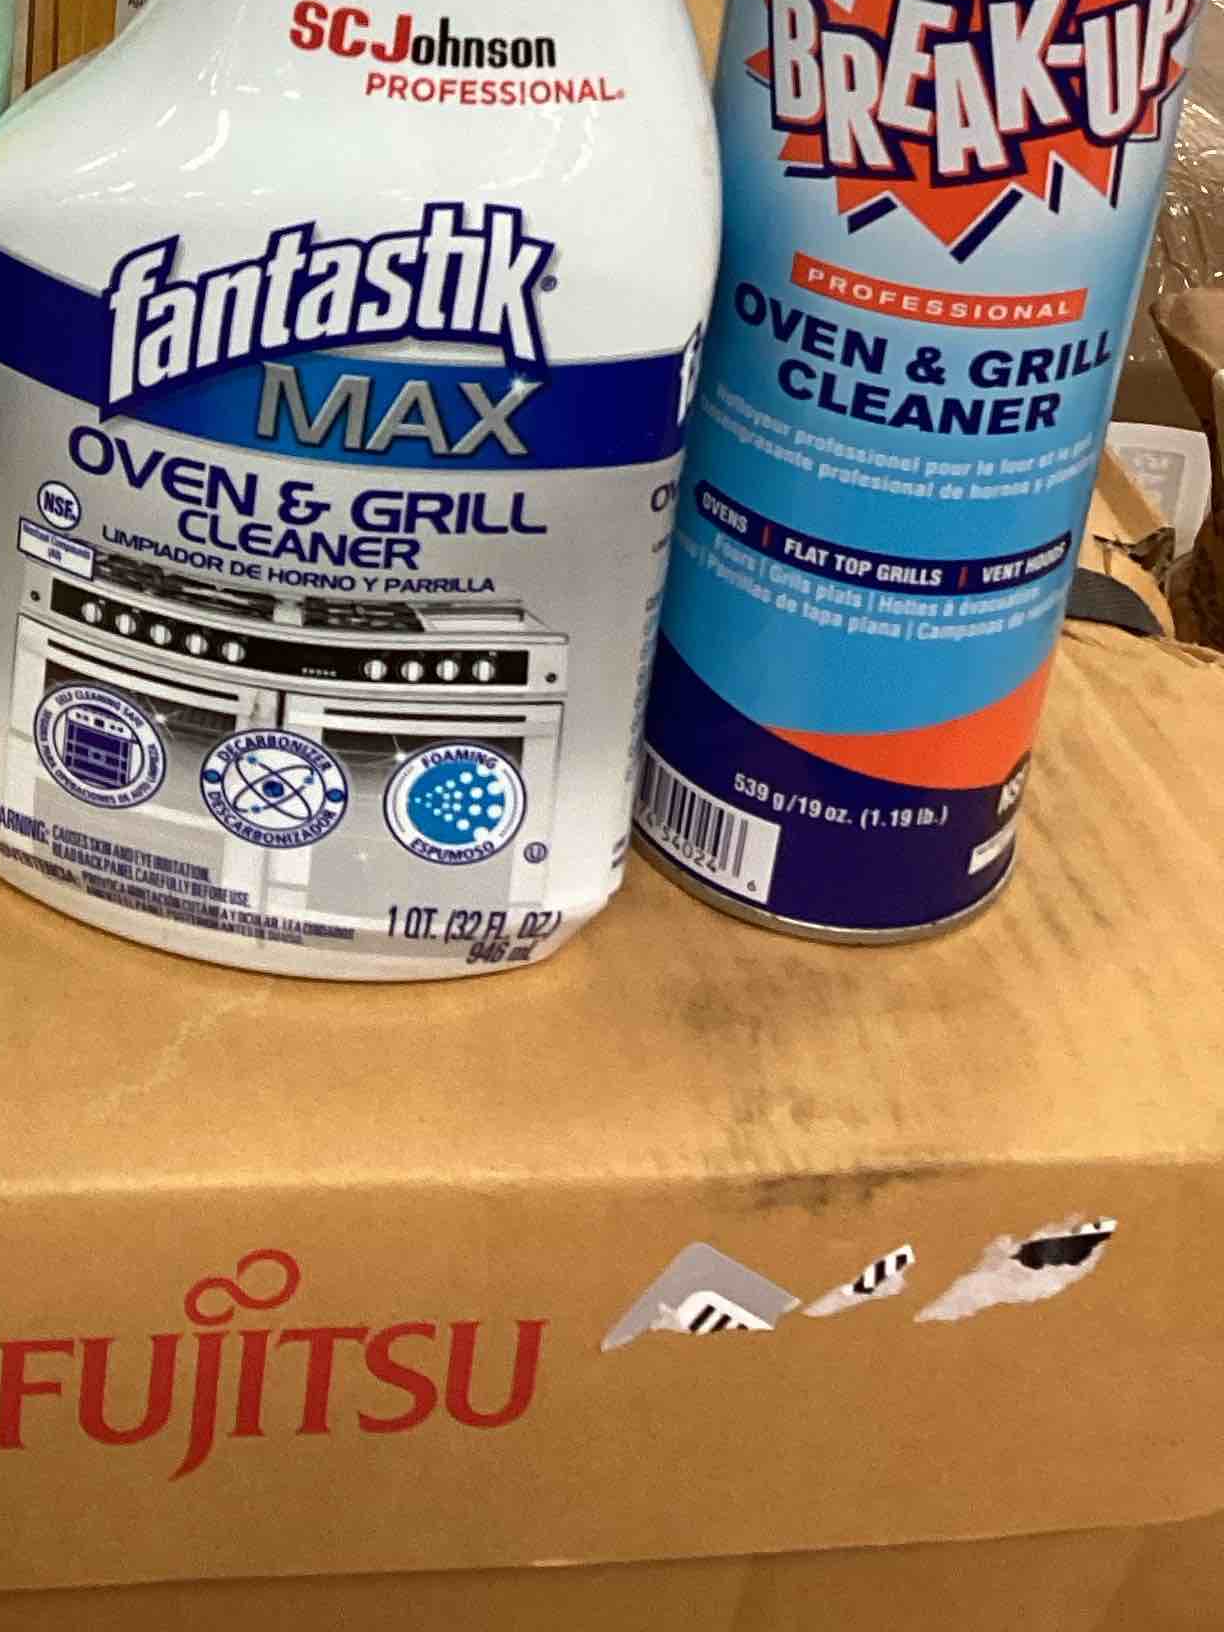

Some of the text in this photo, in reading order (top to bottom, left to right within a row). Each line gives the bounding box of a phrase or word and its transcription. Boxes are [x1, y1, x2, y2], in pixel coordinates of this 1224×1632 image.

[365, 72, 618, 106] PROFESSIONAL
[104, 206, 550, 412] fantastik
[806, 266, 1073, 323] PROFESSIONAL
[733, 280, 890, 376] OVEN
[904, 345, 948, 386] &
[968, 328, 1113, 389] GRILL
[255, 361, 544, 457] MAX
[777, 357, 1062, 437] CLEANER
[43, 489, 76, 521] NSF
[68, 424, 548, 536] OVEN & GRILL
[101, 524, 225, 575] LIMPIADOR
[229, 558, 264, 582] DE
[267, 568, 356, 593] HORNO
[363, 576, 380, 593] Y
[383, 576, 496, 595] PARRILLA
[177, 508, 422, 571] CLEANER
[702, 491, 749, 534] OVENS
[783, 537, 830, 568] FLAT
[833, 553, 873, 578] TOP
[875, 563, 944, 587] GRILLS
[981, 559, 1026, 584] VENT
[215, 734, 334, 773] DECARBONIZER
[420, 748, 499, 770] FOAMING
[207, 790, 338, 845] DESCARBONIZADOR
[733, 772, 769, 804] 539
[824, 804, 854, 826] oz.
[860, 807, 911, 830] (1.19
[916, 804, 949, 828] lb.)
[409, 837, 496, 862] ESPUMOSO
[387, 904, 398, 937] 1
[443, 908, 483, 945] (32
